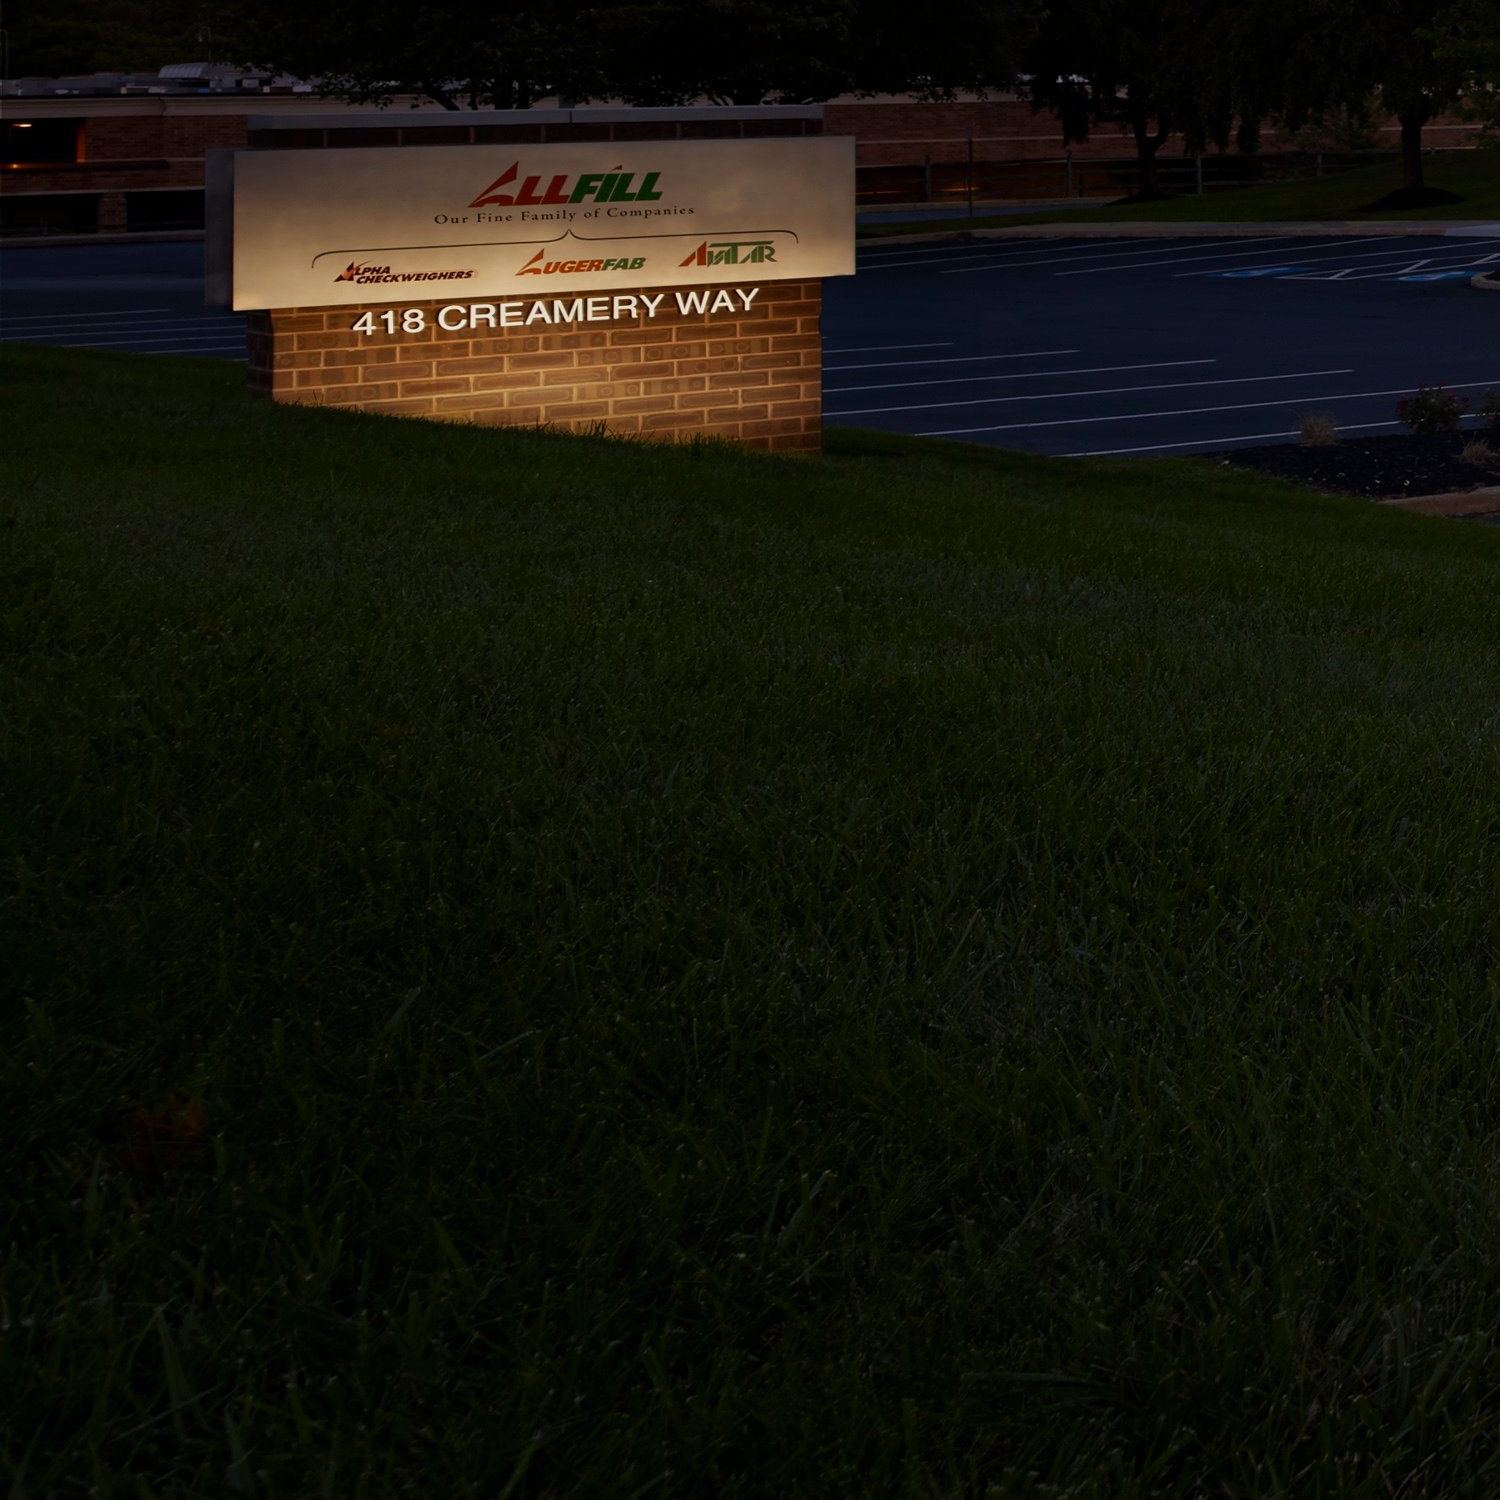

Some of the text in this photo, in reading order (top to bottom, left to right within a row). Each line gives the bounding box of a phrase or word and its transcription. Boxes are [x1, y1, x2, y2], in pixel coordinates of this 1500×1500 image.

[468, 161, 663, 208] ALLFILL
[434, 206, 695, 225] Our Fine Family of Companies
[515, 248, 646, 276] AUGERFAB
[356, 270, 474, 284] CHECKWEIGHERS
[352, 288, 759, 336] 418 CREAMERY WAY
